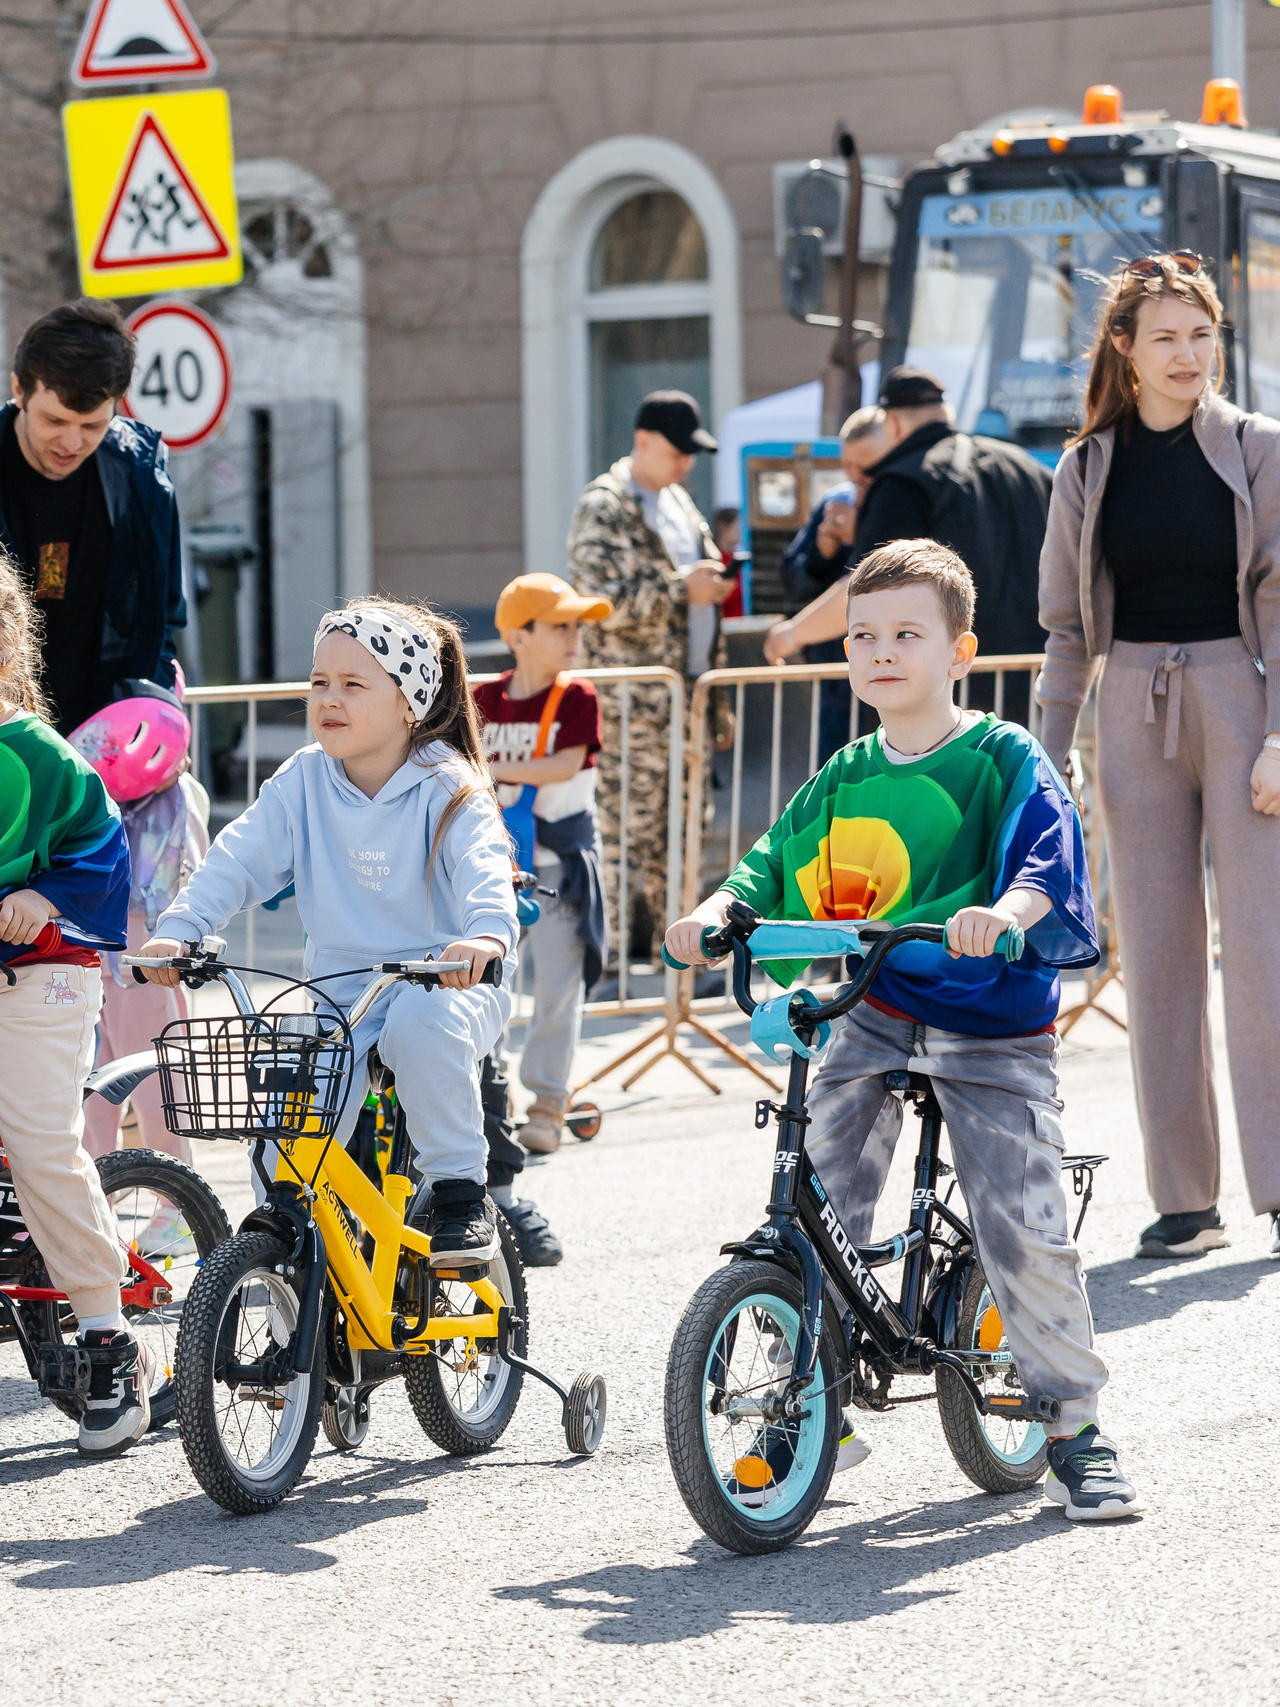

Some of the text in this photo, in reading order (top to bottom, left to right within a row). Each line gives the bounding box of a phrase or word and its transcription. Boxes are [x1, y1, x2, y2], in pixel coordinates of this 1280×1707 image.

[140, 350, 203, 406] 40
[358, 851, 386, 861] YOUR
[376, 866, 391, 876] TO
[322, 1181, 358, 1260] ACTIWELL
[820, 1201, 888, 1313] ROCKET
